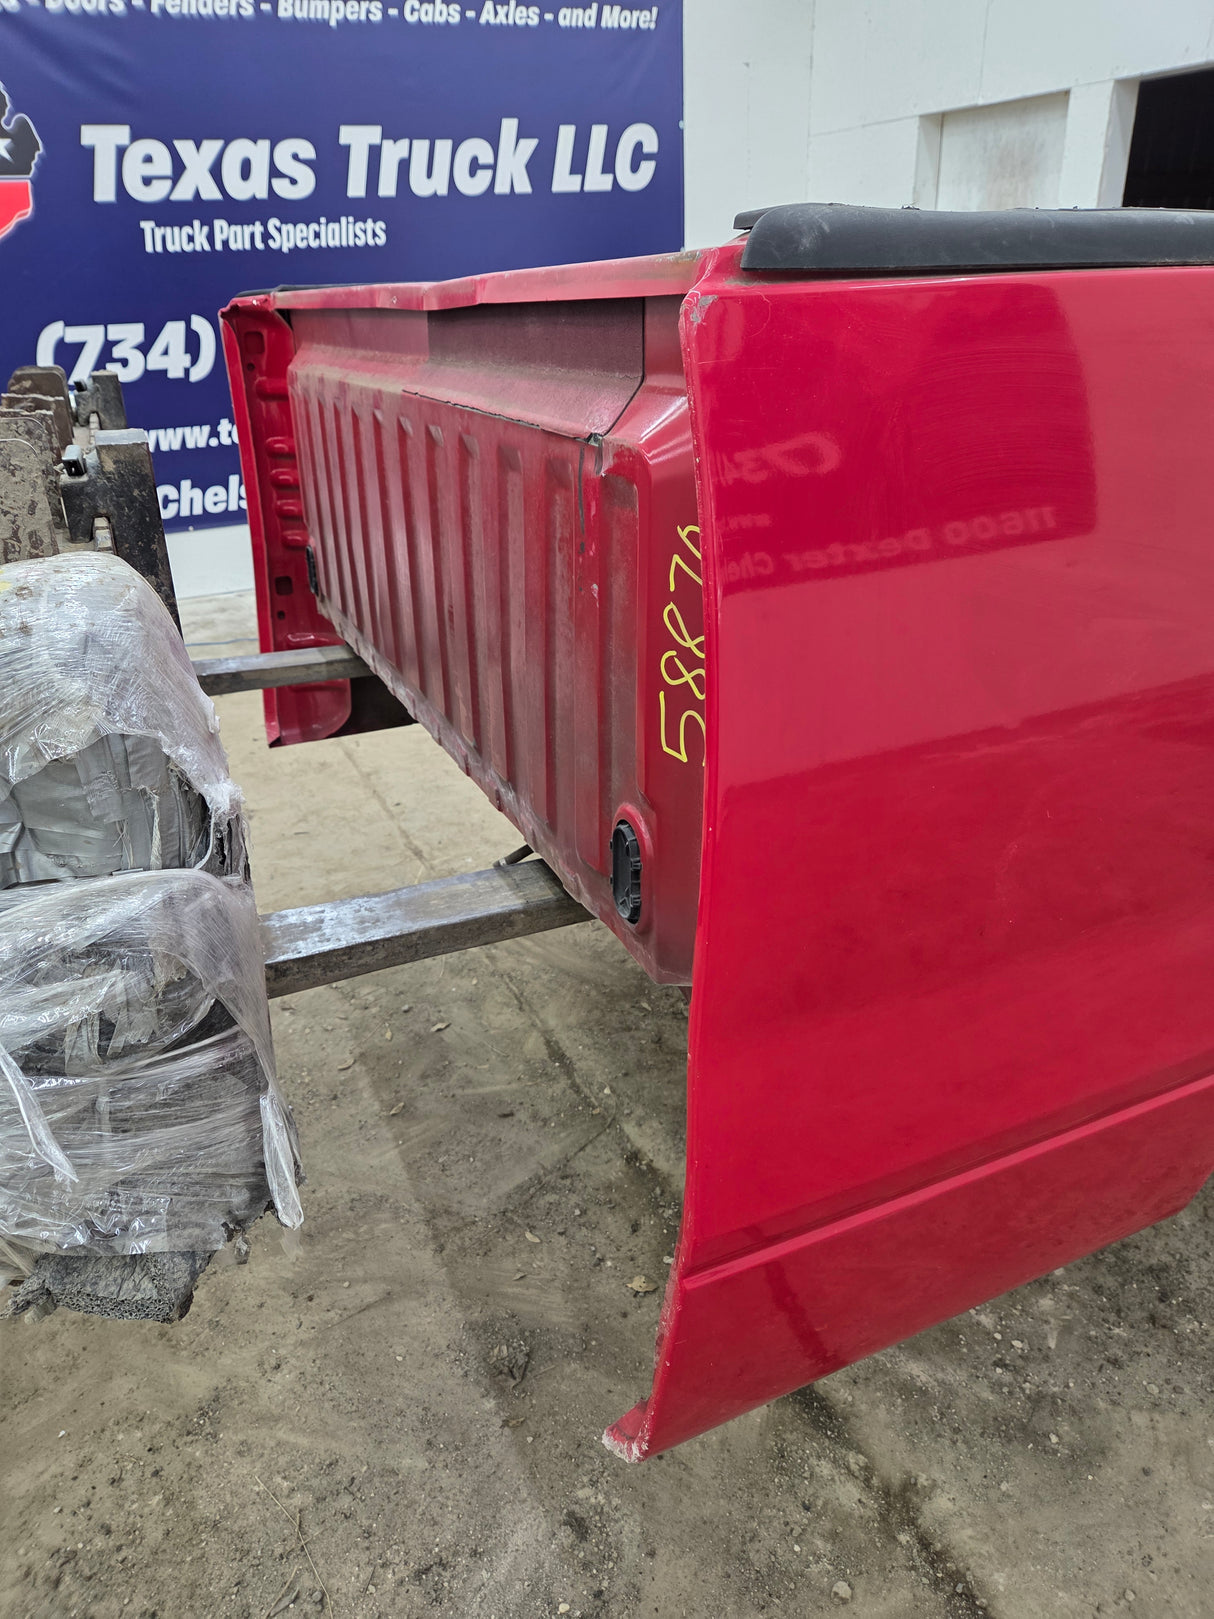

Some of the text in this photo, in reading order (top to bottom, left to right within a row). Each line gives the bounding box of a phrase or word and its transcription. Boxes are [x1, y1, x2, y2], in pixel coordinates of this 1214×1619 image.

[149, 0, 254, 17] Fenders
[277, 0, 383, 26] Bumpers
[403, 0, 461, 24] Cabs
[479, 1, 541, 26] Axles
[558, 3, 598, 28] and
[600, 5, 659, 29] More!
[80, 117, 659, 202] Texas Truck LLC
[139, 216, 387, 253] Truck Part Specialists
[36, 314, 216, 384] (734)
